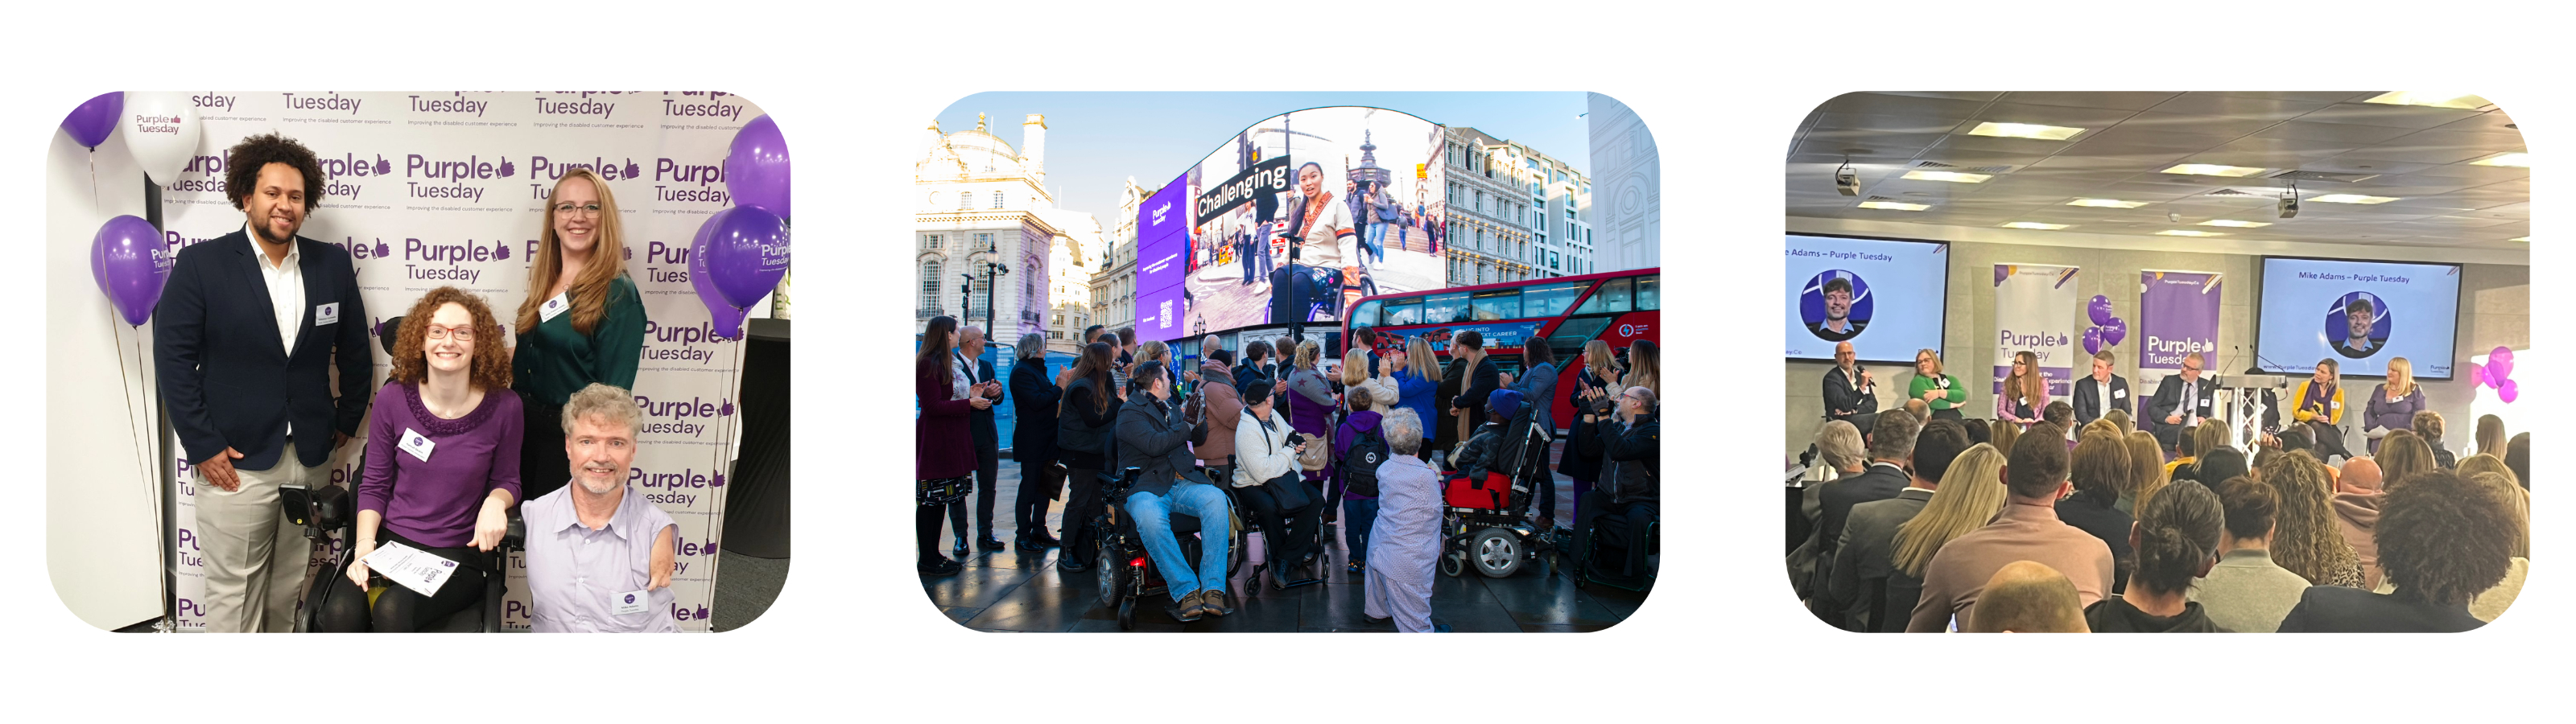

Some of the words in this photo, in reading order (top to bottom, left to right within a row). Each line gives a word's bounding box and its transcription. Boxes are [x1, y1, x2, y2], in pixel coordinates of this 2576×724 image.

[192, 92, 236, 112] sday
[283, 93, 361, 115] Tuesday
[408, 96, 488, 117] Tuesday
[535, 97, 615, 119] Tuesday
[663, 100, 743, 121] Tuesday
[137, 114, 169, 126] Purple
[138, 124, 179, 135] Tuesday
[183, 150, 229, 177] urpl
[319, 153, 369, 180] rple
[407, 154, 493, 183] Purple
[655, 158, 725, 187] Purpl
[167, 177, 227, 192] uesda
[321, 180, 361, 200] sday
[407, 182, 484, 204] Tuesday
[1198, 165, 1287, 217] Challenging
[654, 186, 730, 207] Tuesday
[405, 238, 489, 265] Purple
[647, 241, 690, 264] Pur
[1791, 249, 1820, 257] Adams
[1830, 251, 1856, 260] Purple
[1859, 253, 1893, 262] Tuesday
[405, 265, 481, 284] Tuesday
[646, 267, 691, 282] Tues
[2354, 274, 2377, 282] Purple
[2380, 275, 2409, 284] Tuesday
[2001, 330, 2055, 349] Purple
[2148, 336, 2201, 355] Purple
[641, 345, 713, 364] Tuesday
[634, 396, 715, 421] Purple
[642, 420, 705, 438] uesday
[626, 467, 706, 492] Purple
[646, 491, 696, 508] esday
